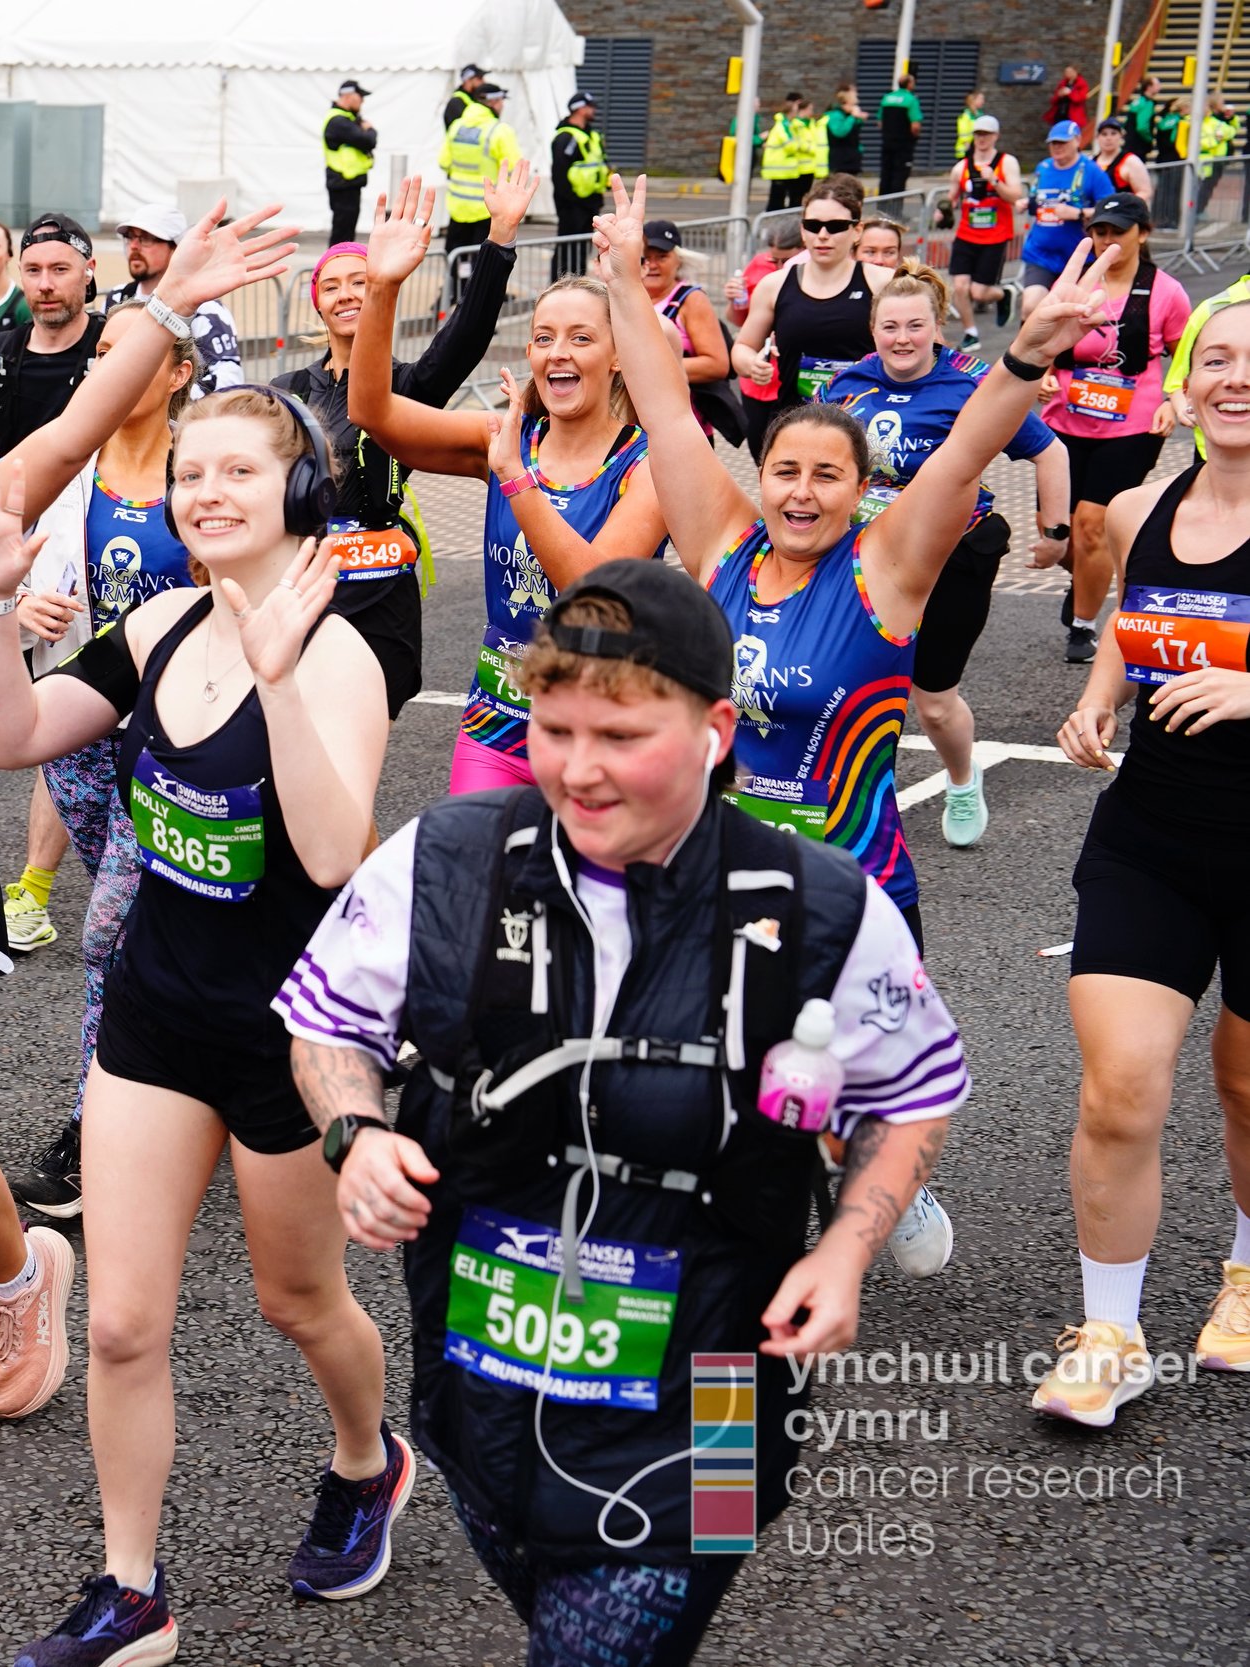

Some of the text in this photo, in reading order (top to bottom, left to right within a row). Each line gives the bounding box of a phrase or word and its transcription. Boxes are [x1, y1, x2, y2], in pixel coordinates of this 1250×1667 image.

[1077, 390, 1119, 411] 2586
[866, 433, 933, 452] RGAN'S
[113, 507, 149, 523] RCS
[347, 543, 402, 566] 3549
[488, 540, 544, 574] MORG
[88, 562, 176, 593] ORGAN'S
[1180, 593, 1228, 607] SWANSEA
[1117, 617, 1175, 635] NATALIE
[1152, 637, 1211, 669] 174
[731, 664, 813, 690] GAN'S
[730, 688, 779, 711] RMY
[820, 686, 846, 719] WALES
[807, 720, 827, 753] SOUTH
[803, 752, 815, 764] IN
[178, 783, 228, 805] SWANSEA
[756, 776, 804, 792] SWANSEA
[133, 785, 169, 820] HOLLY
[791, 809, 826, 818] MORGAN'S
[206, 833, 262, 842] RESEARCH WALES
[235, 824, 261, 833] CANCER
[152, 817, 232, 877] 8365
[151, 858, 233, 899] #RUNSWANSEA
[553, 1236, 635, 1266] SANSEA
[454, 1253, 516, 1294] ELLIE
[618, 1296, 672, 1312] MAGGIE'S
[36, 1290, 50, 1345] HOKA
[616, 1308, 671, 1324] SWANSEA
[486, 1293, 622, 1368] 5093
[479, 1353, 612, 1401] #RUNSWANSEA
